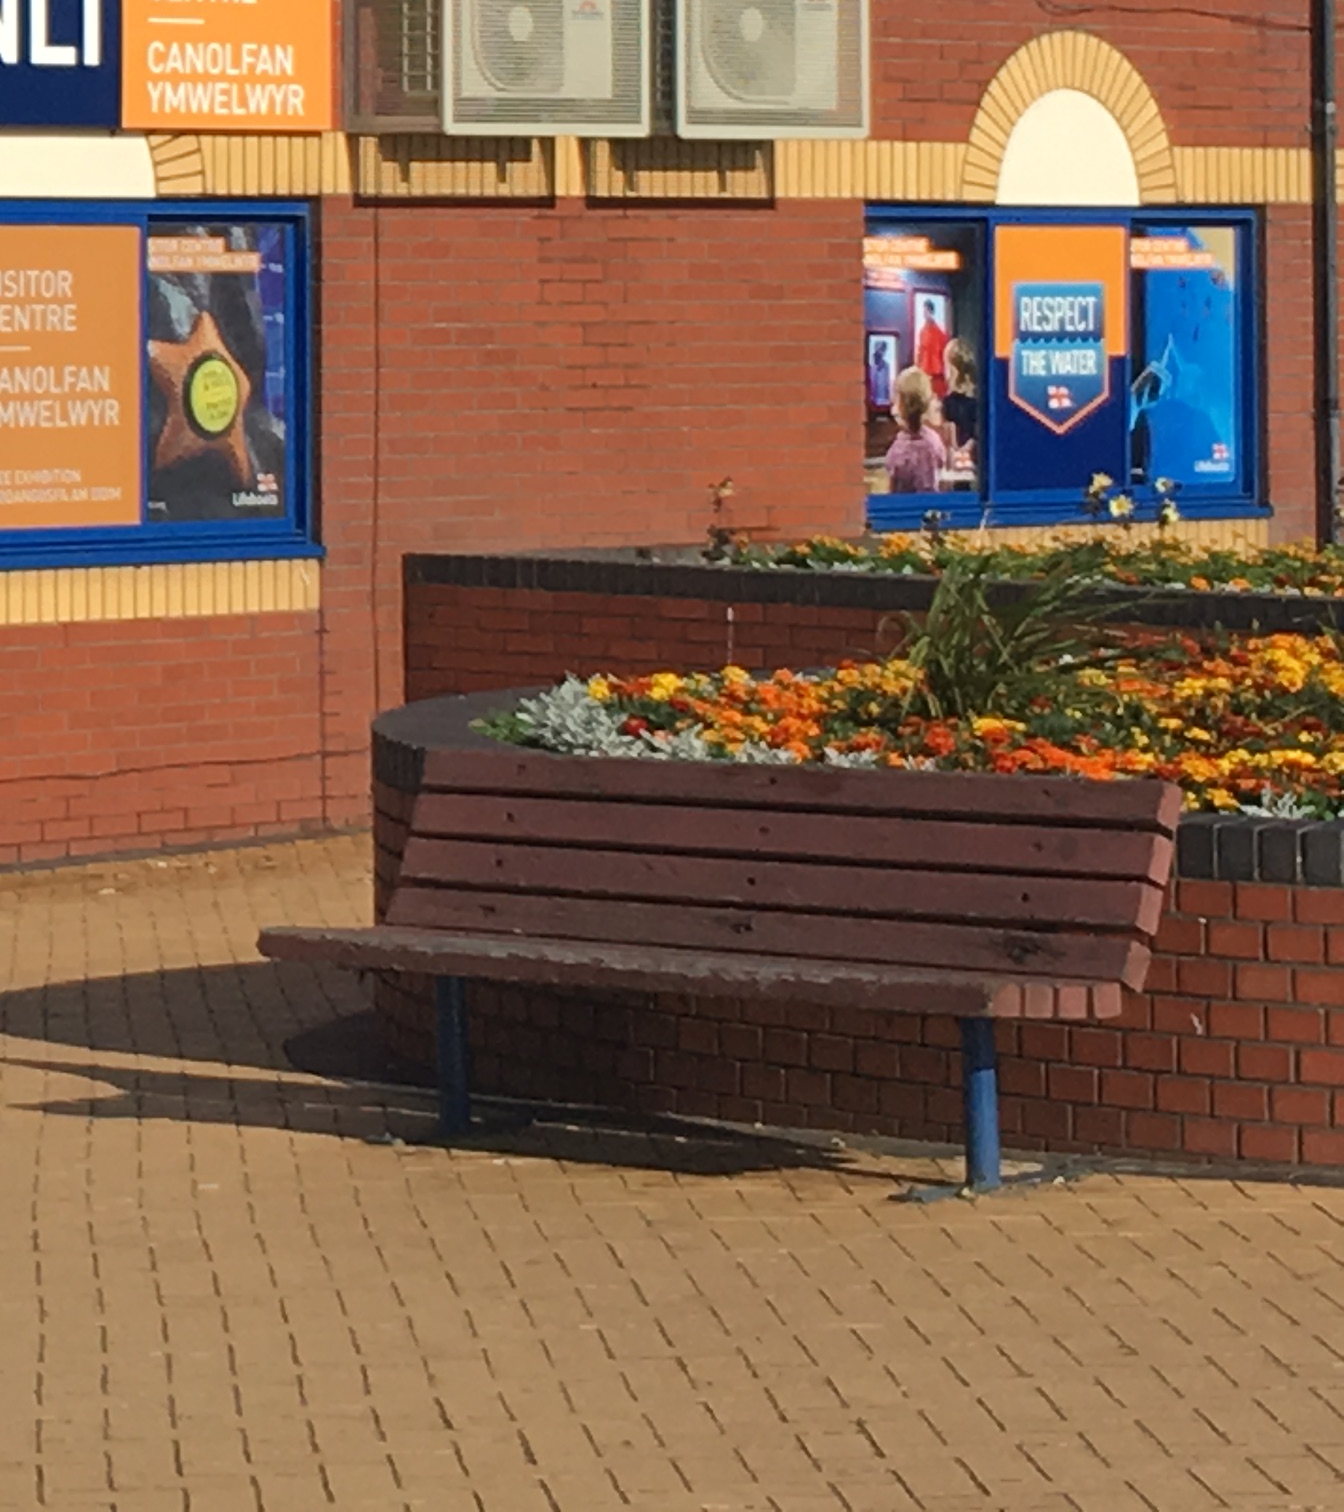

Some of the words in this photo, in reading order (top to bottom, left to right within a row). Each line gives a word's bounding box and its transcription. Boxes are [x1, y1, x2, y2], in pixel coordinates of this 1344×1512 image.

[147, 40, 294, 76] CANOLFAN
[147, 80, 305, 117] YMWELWYR
[1020, 296, 1097, 331] RESPECT
[1021, 349, 1047, 376] THE
[1049, 349, 1098, 376] WATER
